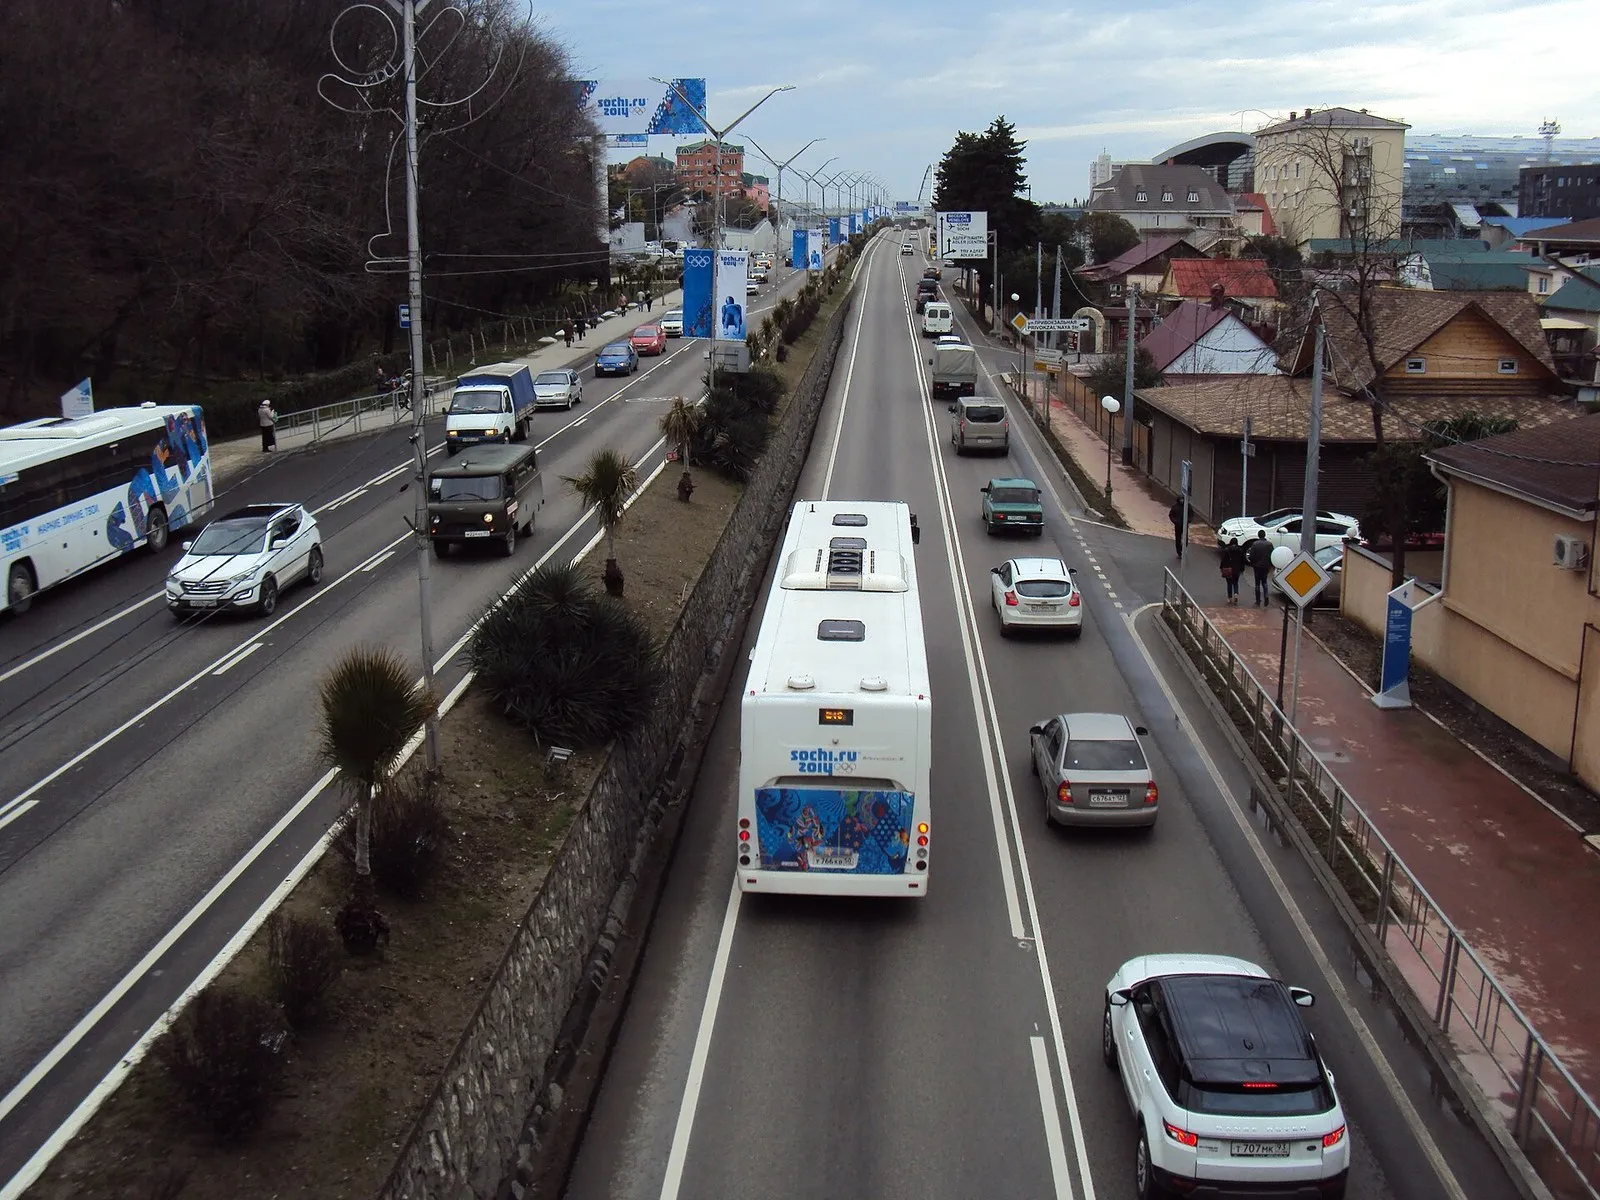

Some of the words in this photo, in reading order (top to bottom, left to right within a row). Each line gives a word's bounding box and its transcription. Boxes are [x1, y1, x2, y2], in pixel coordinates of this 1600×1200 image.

[597, 97, 646, 107] sochi.ru
[603, 107, 629, 117] 2014
[790, 748, 857, 762] sochi.ru
[798, 762, 833, 776] 2014
